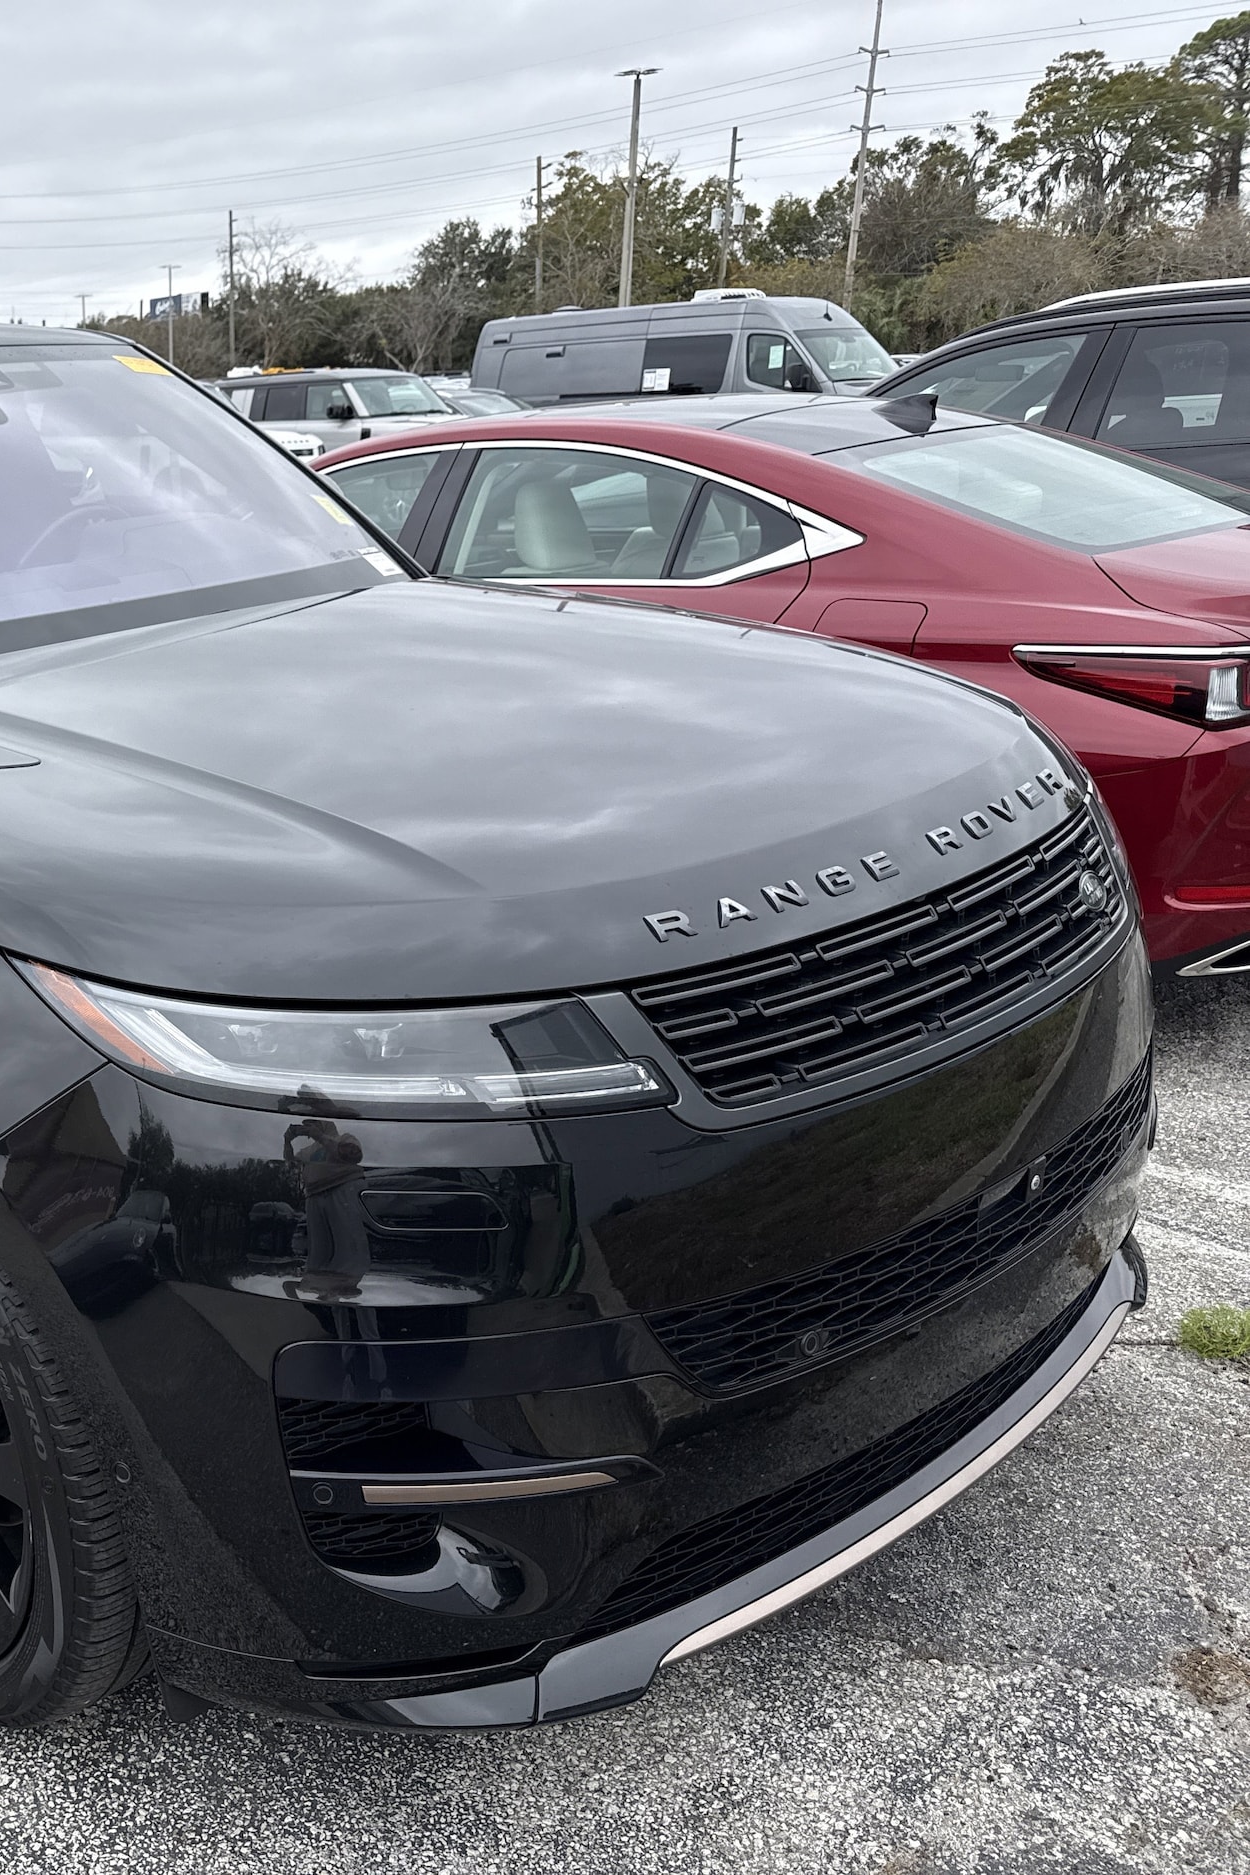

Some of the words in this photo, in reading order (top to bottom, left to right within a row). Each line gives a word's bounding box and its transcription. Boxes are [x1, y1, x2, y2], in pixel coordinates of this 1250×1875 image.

[642, 850, 901, 943] RANGE
[924, 767, 1071, 856] ROVER
[8, 1361, 48, 1462] ZERO
